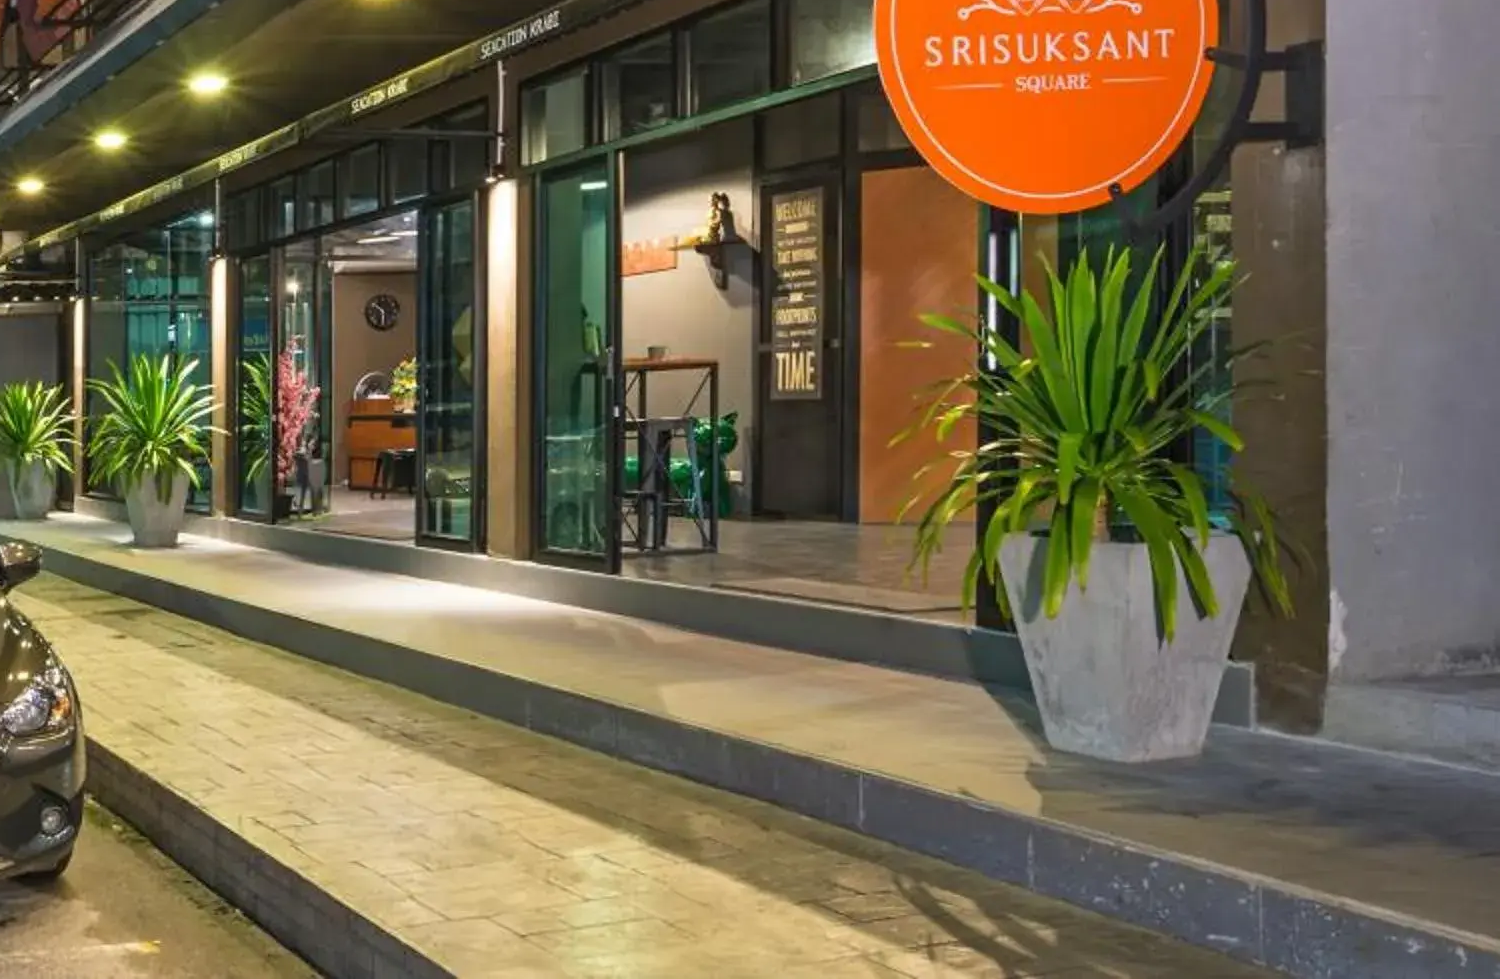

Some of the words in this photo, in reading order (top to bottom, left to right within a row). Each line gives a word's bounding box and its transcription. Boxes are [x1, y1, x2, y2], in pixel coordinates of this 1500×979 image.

[529, 10, 560, 38] KRABI
[924, 28, 1176, 68] SRISUKSANT
[1015, 74, 1092, 94] SQUARE
[776, 352, 816, 391] TIME
